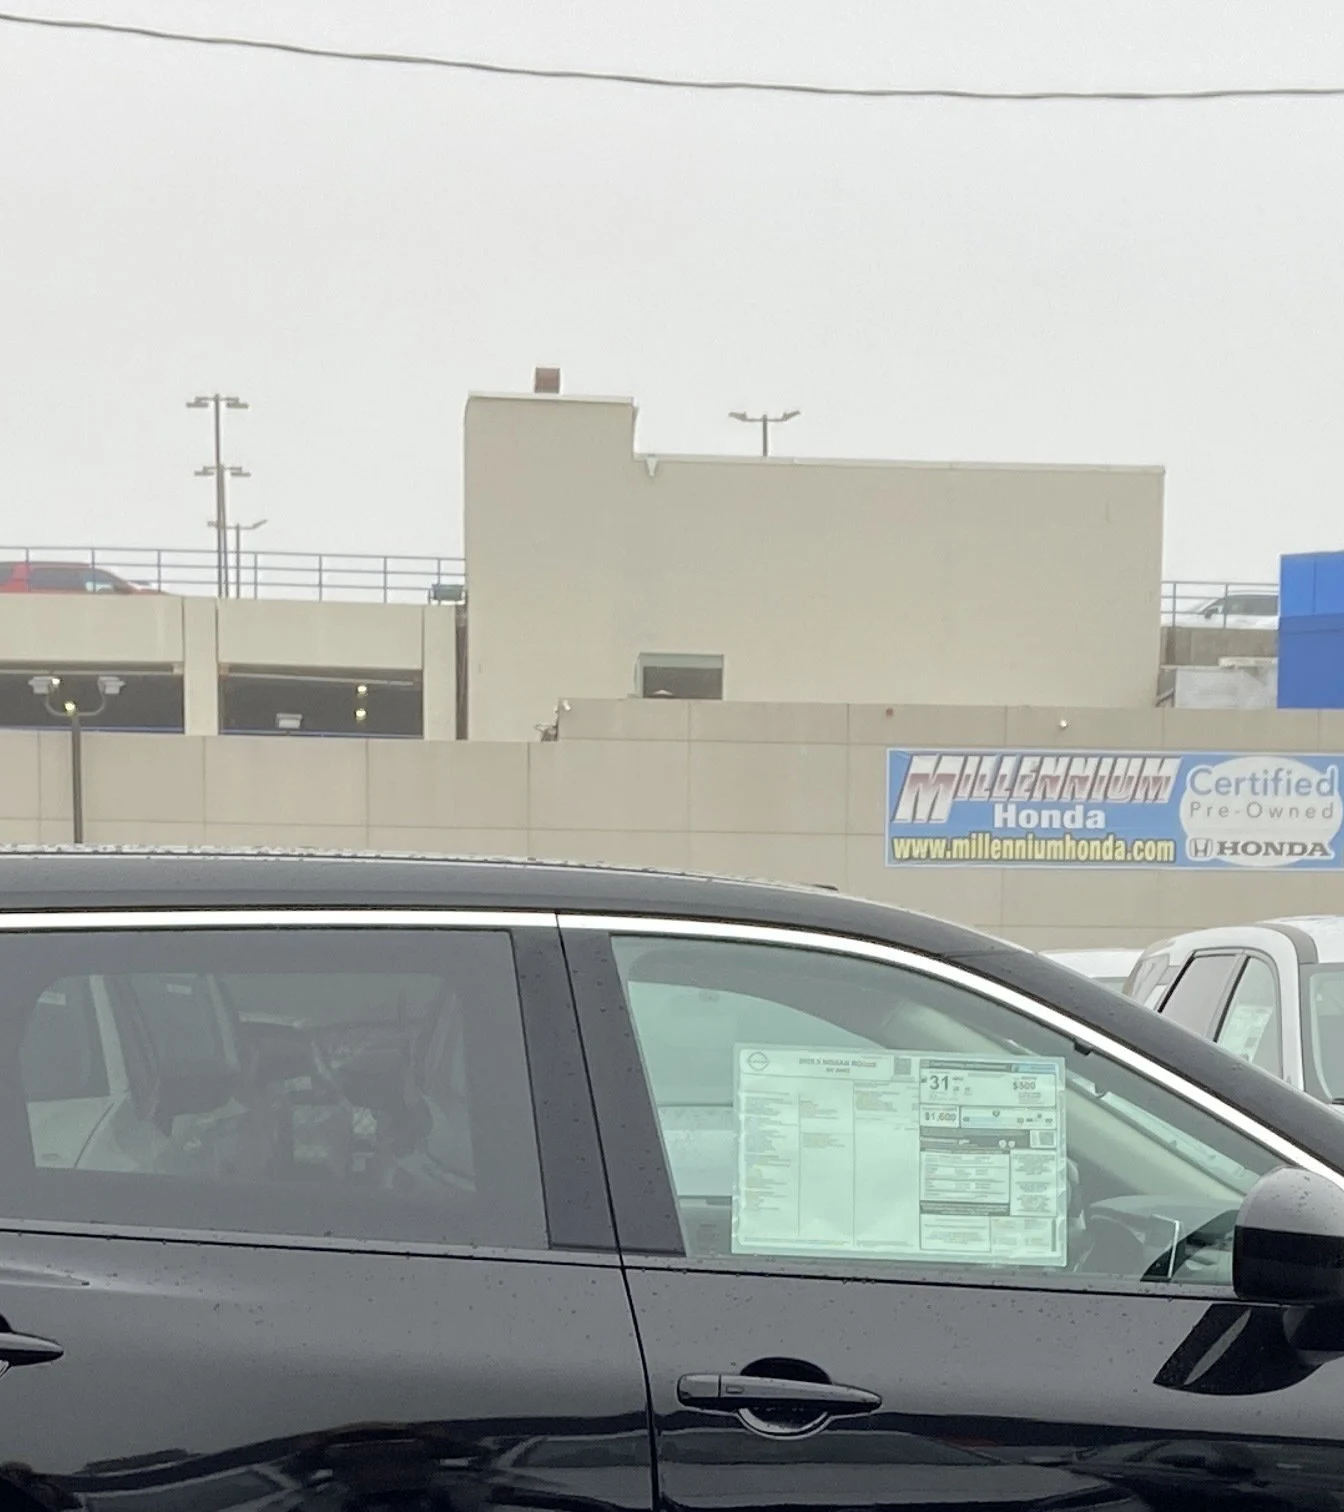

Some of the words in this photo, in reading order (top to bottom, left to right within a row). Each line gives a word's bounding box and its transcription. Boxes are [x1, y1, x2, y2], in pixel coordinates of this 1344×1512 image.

[891, 755, 1182, 823] MILLENNIUM
[1190, 767, 1335, 797] Certified
[993, 803, 1106, 829] Honda
[1190, 802, 1334, 819] Pre-Owned
[892, 833, 1175, 861] www.millenniumhonda.com
[1217, 841, 1330, 857] HONDA
[929, 1075, 949, 1091] 31
